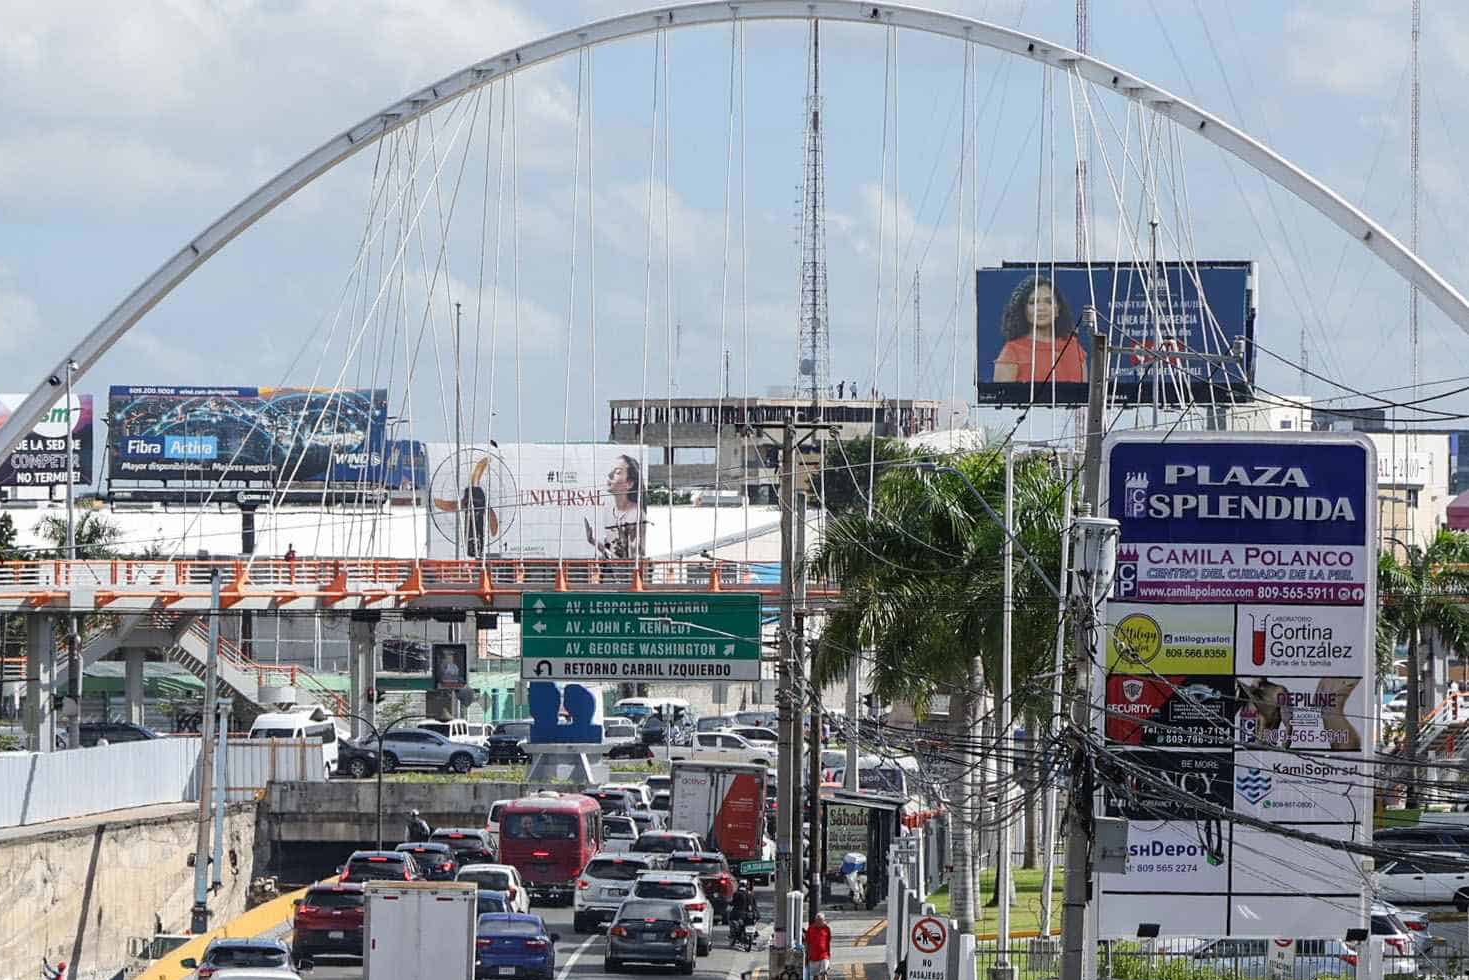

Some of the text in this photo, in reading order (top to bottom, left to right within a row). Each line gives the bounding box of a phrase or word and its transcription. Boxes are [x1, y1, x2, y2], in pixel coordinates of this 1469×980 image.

[30, 440, 43, 451] LA
[44, 440, 65, 451] SED
[127, 440, 212, 455] Fibra Activa
[11, 454, 80, 469] COMPETR
[121, 463, 147, 473] Mayor
[17, 472, 81, 484] NO TERMIE!
[1164, 464, 1310, 488] PLAZA
[520, 489, 606, 506] UNIVERSAL
[1148, 493, 1356, 522] SPLENDIDA
[1146, 545, 1355, 568] CAMILA POLANCO
[1146, 567, 1199, 580] CENTRO
[1201, 568, 1226, 580] DEL
[1227, 568, 1287, 581] CUIDADO
[1289, 569, 1308, 581] DE
[1309, 570, 1326, 581] LA
[1139, 584, 1335, 600] www.camilapolanco.com 809-565-5911
[566, 601, 584, 613] AV.
[589, 601, 650, 614] LEOPOLDO
[566, 621, 584, 634] AV.
[589, 621, 620, 634] JOHN
[625, 622, 635, 634] F.
[1270, 622, 1333, 640] Cortina
[566, 643, 716, 657] AV. GEORGE WASHINGTON
[1269, 641, 1353, 658] González
[564, 662, 731, 678] RETORNO CARRIL IZQUIERDO
[1277, 692, 1337, 708] DEPILINE
[1181, 760, 1220, 769] BE MORE
[1137, 864, 1198, 873] 809 565 2274
[922, 958, 932, 968] NO
[909, 969, 944, 980] PASAJEROS
